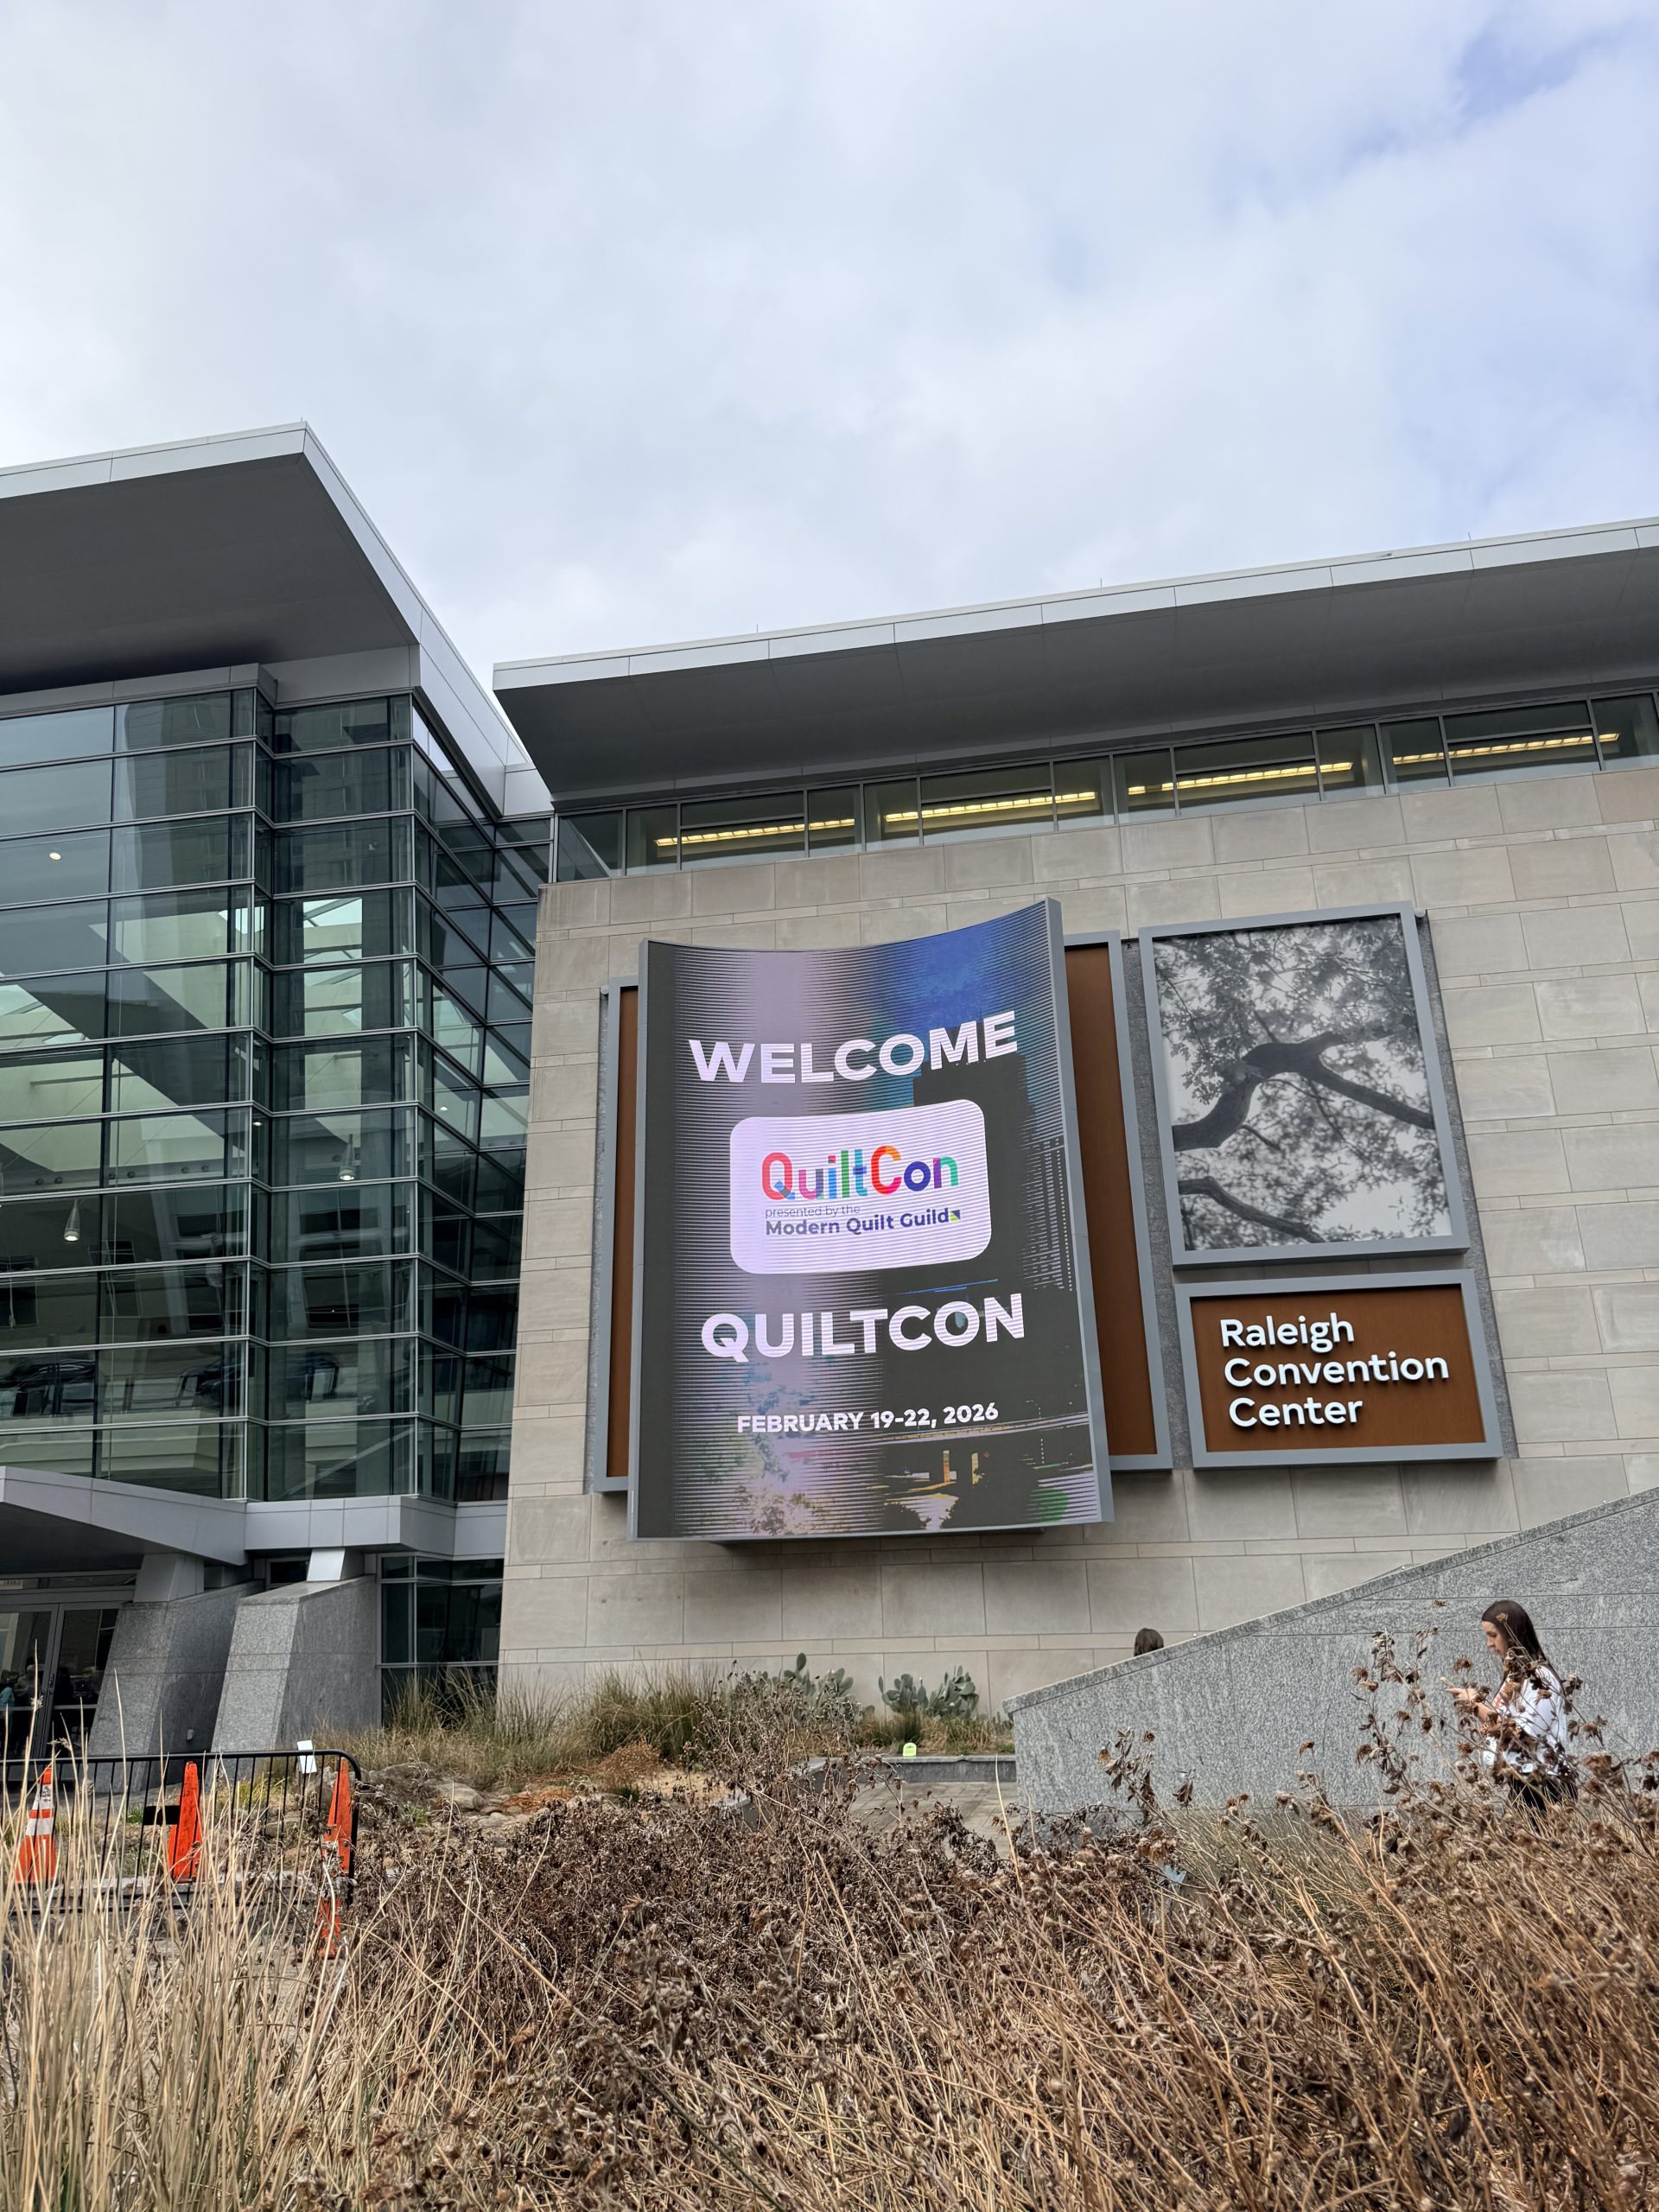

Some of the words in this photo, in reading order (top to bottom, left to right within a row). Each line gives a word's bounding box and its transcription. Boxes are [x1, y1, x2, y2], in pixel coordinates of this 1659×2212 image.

[689, 1010, 1018, 1084] WELCOME
[761, 1145, 959, 1200] QuiltCon
[766, 1206, 822, 1219] presented
[825, 1205, 838, 1217] by
[842, 1205, 861, 1215] the
[766, 1219, 840, 1236] Modern
[846, 1214, 894, 1235] Quilt
[899, 1207, 950, 1228] Guild
[701, 1293, 1025, 1363] QUILTCON
[1220, 1312, 1354, 1354] Raleigh
[1224, 1351, 1450, 1388] Convention
[737, 1411, 864, 1433] FEBRUARY
[870, 1408, 937, 1429] 19-22,
[943, 1402, 999, 1425] 2026
[1229, 1396, 1363, 1427] Center
